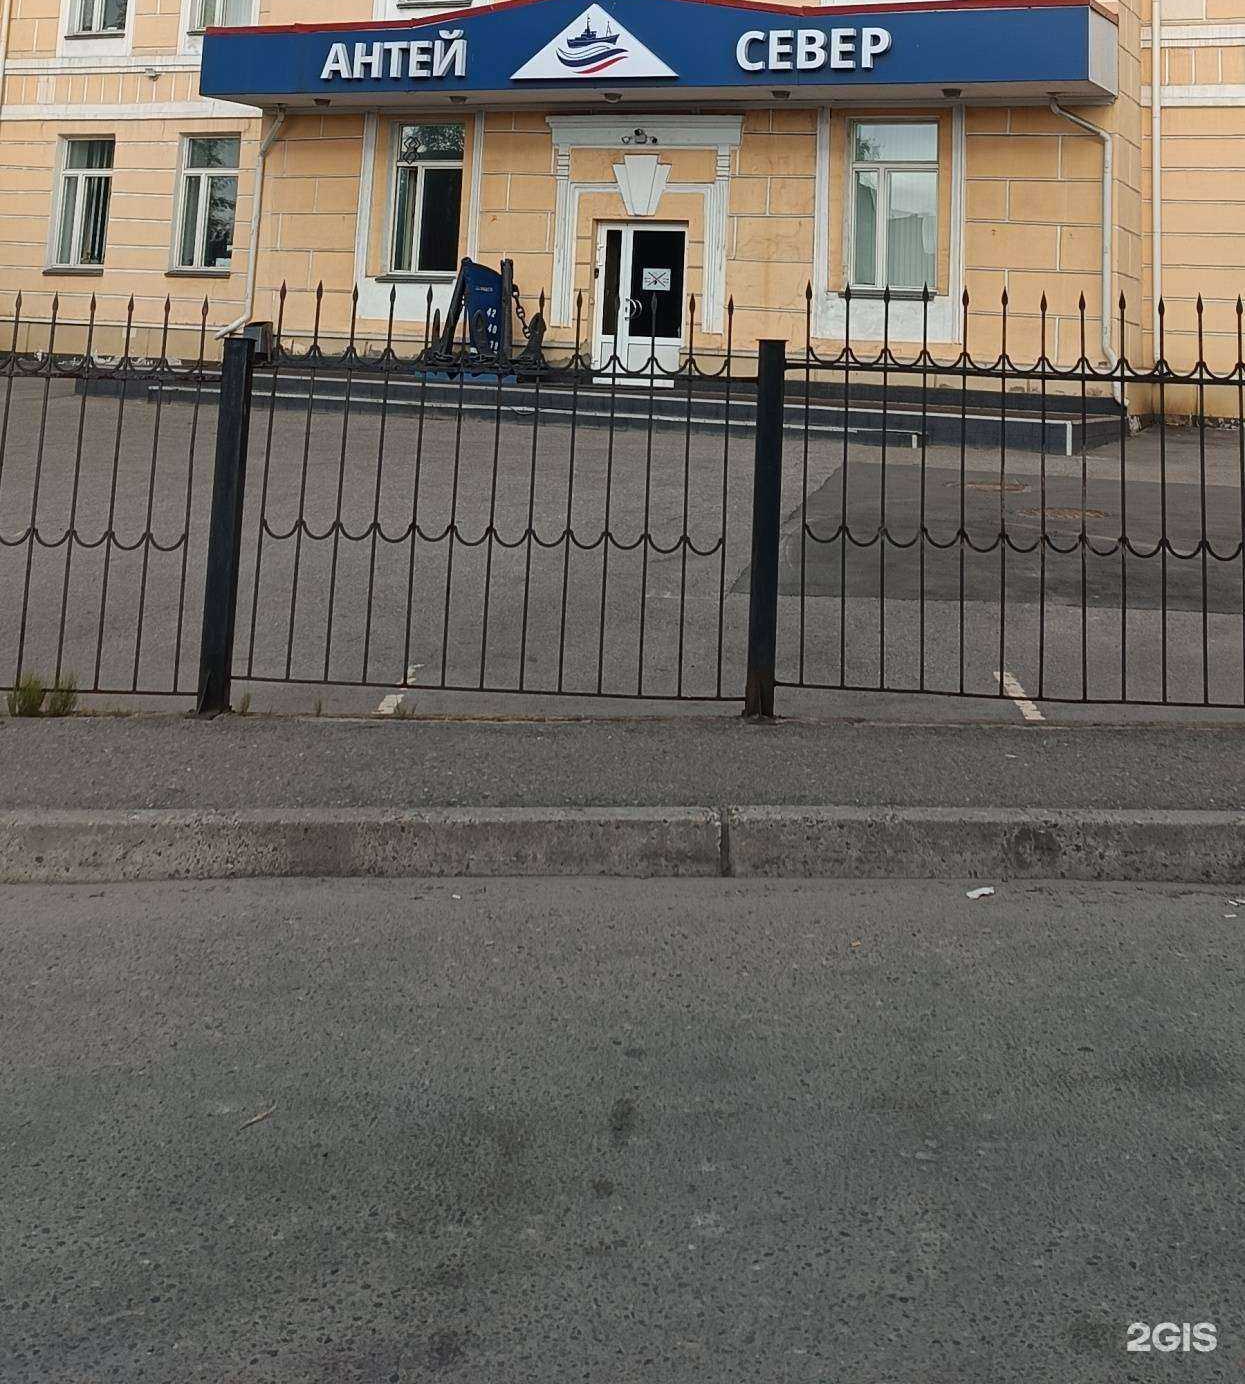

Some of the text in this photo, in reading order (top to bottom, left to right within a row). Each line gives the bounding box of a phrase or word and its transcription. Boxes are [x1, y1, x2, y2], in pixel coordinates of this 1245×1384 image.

[320, 29, 467, 79] АНТЕЙ
[736, 27, 892, 71] СЕВЕР
[486, 307, 497, 318] 42
[487, 323, 498, 334] 40
